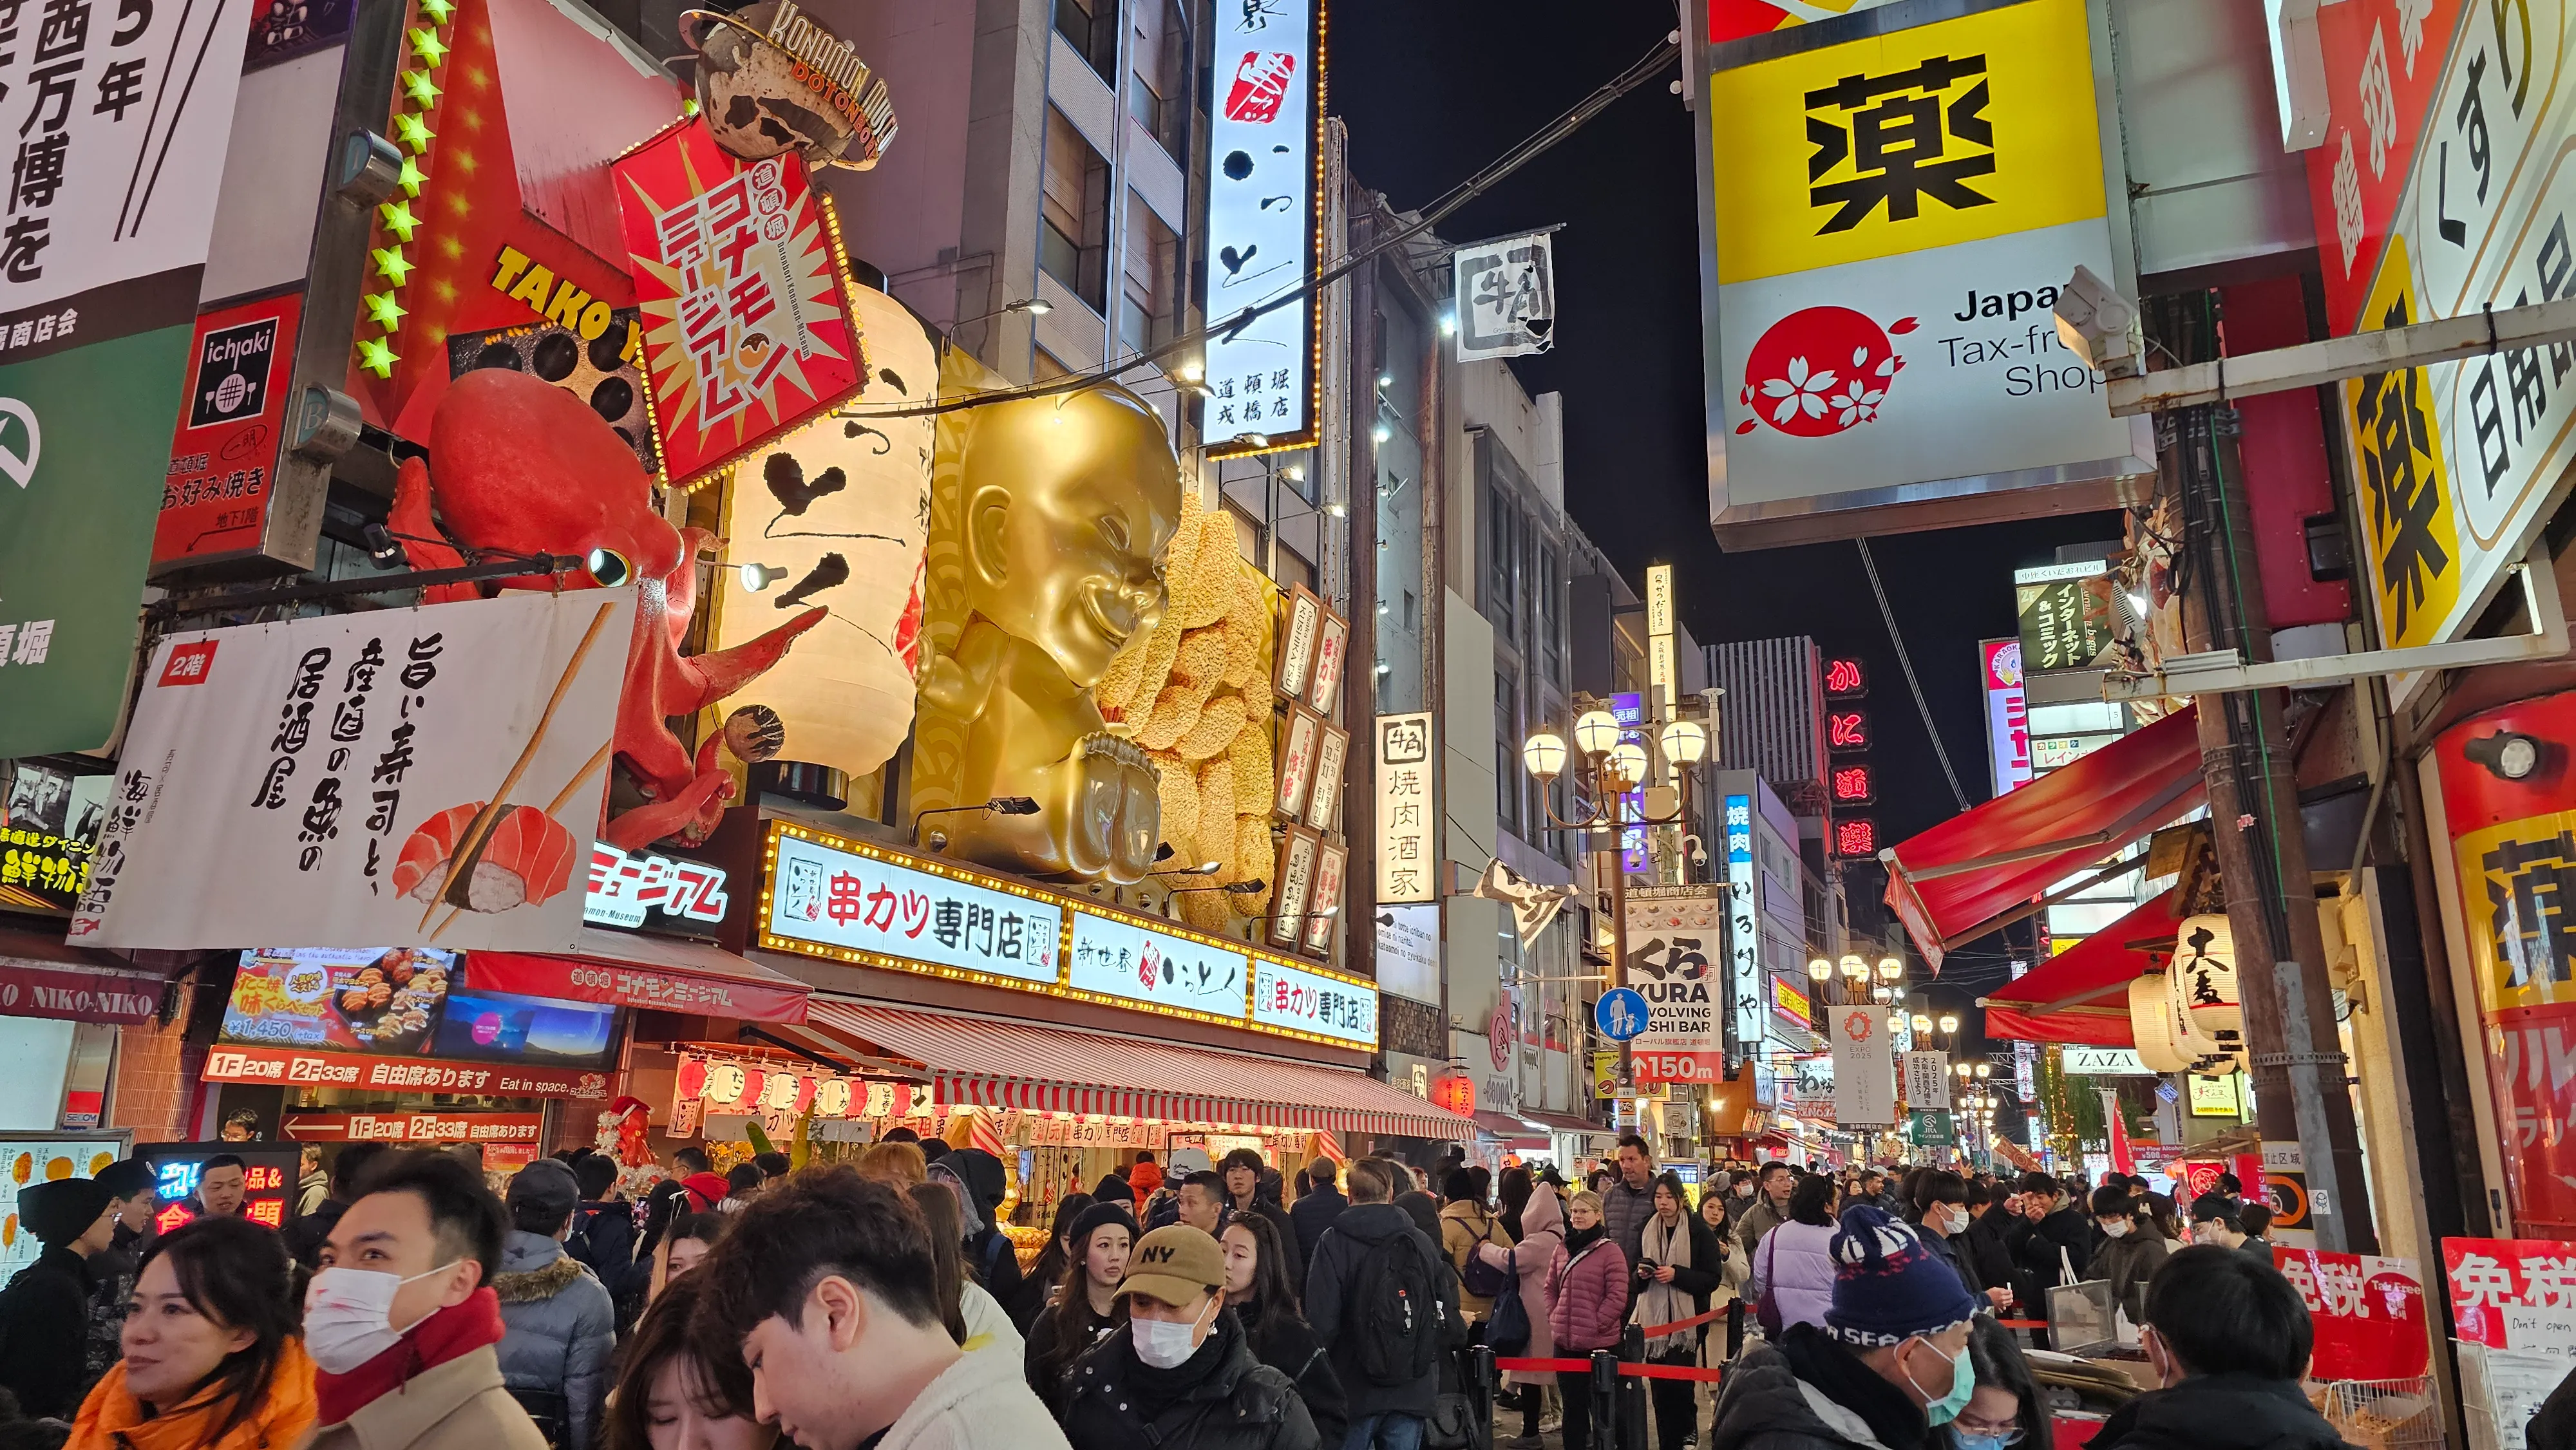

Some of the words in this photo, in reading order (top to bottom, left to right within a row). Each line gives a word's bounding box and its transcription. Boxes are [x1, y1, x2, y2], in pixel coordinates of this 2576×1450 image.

[766, 0, 871, 102] KONAMON
[1803, 52, 1999, 238] 薬
[752, 160, 790, 241] 道頓堀
[490, 245, 612, 341] TAKO
[777, 240, 795, 281] Dotonbori
[787, 282, 812, 359] Konamon-Museum
[657, 201, 751, 430] ミュージアム
[1938, 325, 2072, 368] Tax-fr
[1217, 368, 1290, 400] 道頓堀
[1217, 394, 1290, 426] 戎橋店
[167, 452, 211, 476] 道頓堀
[2355, 288, 2450, 647] 薬
[160, 466, 265, 511] お好み焼き
[214, 507, 260, 529] 地下1階
[2020, 563, 2102, 580] 中座くいだおれビル
[1654, 574, 1667, 627] 串かつだるま
[2020, 590, 2036, 603] 2F
[1303, 610, 1313, 639] Osaka
[2038, 600, 2058, 669] &コミック
[2056, 583, 2081, 666] インターネット
[1285, 604, 1307, 688] KUSHIKATSU
[1994, 644, 2020, 671] KARAOK
[167, 652, 204, 681] 2階
[1315, 636, 1334, 703] 串カツ
[251, 646, 333, 811] 居酒屋
[1615, 710, 1637, 722] 元祖
[297, 636, 385, 872] 産直の魚の
[1321, 744, 1332, 779] 꼬치
[1330, 740, 1340, 778] 오사카
[1826, 660, 1873, 854] かに道楽
[2036, 739, 2079, 751] カラオケ
[363, 631, 444, 898] 旨い寿司と、
[1313, 786, 1325, 823] 튀김
[75, 769, 153, 915] 海鮮物語
[1388, 769, 1422, 896] 焼肉酒家
[1726, 805, 1750, 854] 焼肉
[587, 851, 722, 916] ミュージアム
[1624, 885, 1709, 899] 道頓堀商店会
[583, 905, 641, 924] amon-Museum
[828, 869, 1025, 961] 串カツ専門店
[1077, 936, 1134, 974] 新世界
[1627, 936, 1709, 982] くら
[1732, 880, 1758, 1020] いろりや
[238, 973, 283, 993] たこ焼
[290, 972, 323, 986] 人気の味
[571, 968, 611, 990] 道頓堀
[616, 974, 734, 1008] コナモンミュージアム
[1628, 982, 1712, 1003] KURA
[29, 986, 153, 1016] NIKO-NIKO
[240, 994, 325, 1017] 味くらべセット
[1274, 976, 1359, 1030] 串カツ専門店
[1649, 1007, 1712, 1019] VOLVING
[228, 1020, 290, 1038] ¥1,450
[294, 1031, 325, 1041] (+tax)
[1678, 1020, 1711, 1033] BAR
[214, 1055, 242, 1077] 1F
[242, 1060, 285, 1078] 20席
[292, 1059, 323, 1081] 2F
[322, 1064, 359, 1083] 33席
[368, 1062, 491, 1091] 自由席あります
[1649, 1056, 1714, 1079] 150m
[1912, 1057, 1921, 1095] 成功させよう
[1930, 1057, 1939, 1094] 2025年
[2077, 1052, 2135, 1067] ZAZA
[500, 1077, 519, 1091] Eat
[522, 1078, 533, 1091] in
[535, 1080, 570, 1093] space.
[786, 1078, 800, 1105] キス
[839, 1084, 851, 1109] いか
[1795, 1069, 1835, 1094] わな
[1920, 1057, 1931, 1107] 大阪・関西万博を
[66, 1113, 97, 1122] SECOM
[350, 1116, 375, 1139] 1F
[374, 1120, 405, 1139] 20席
[409, 1118, 436, 1140] 2F
[435, 1120, 468, 1140] 33席
[469, 1124, 538, 1139] 自由席あります
[1141, 1245, 1176, 1265] NY
[2280, 1256, 2371, 1319] 免税
[2394, 1282, 2422, 1295] Free
[2449, 1252, 2576, 1310] 免税
[1844, 1326, 1900, 1347] SEA
[2512, 1317, 2537, 1330] Don't
[2546, 1322, 2572, 1334] open
